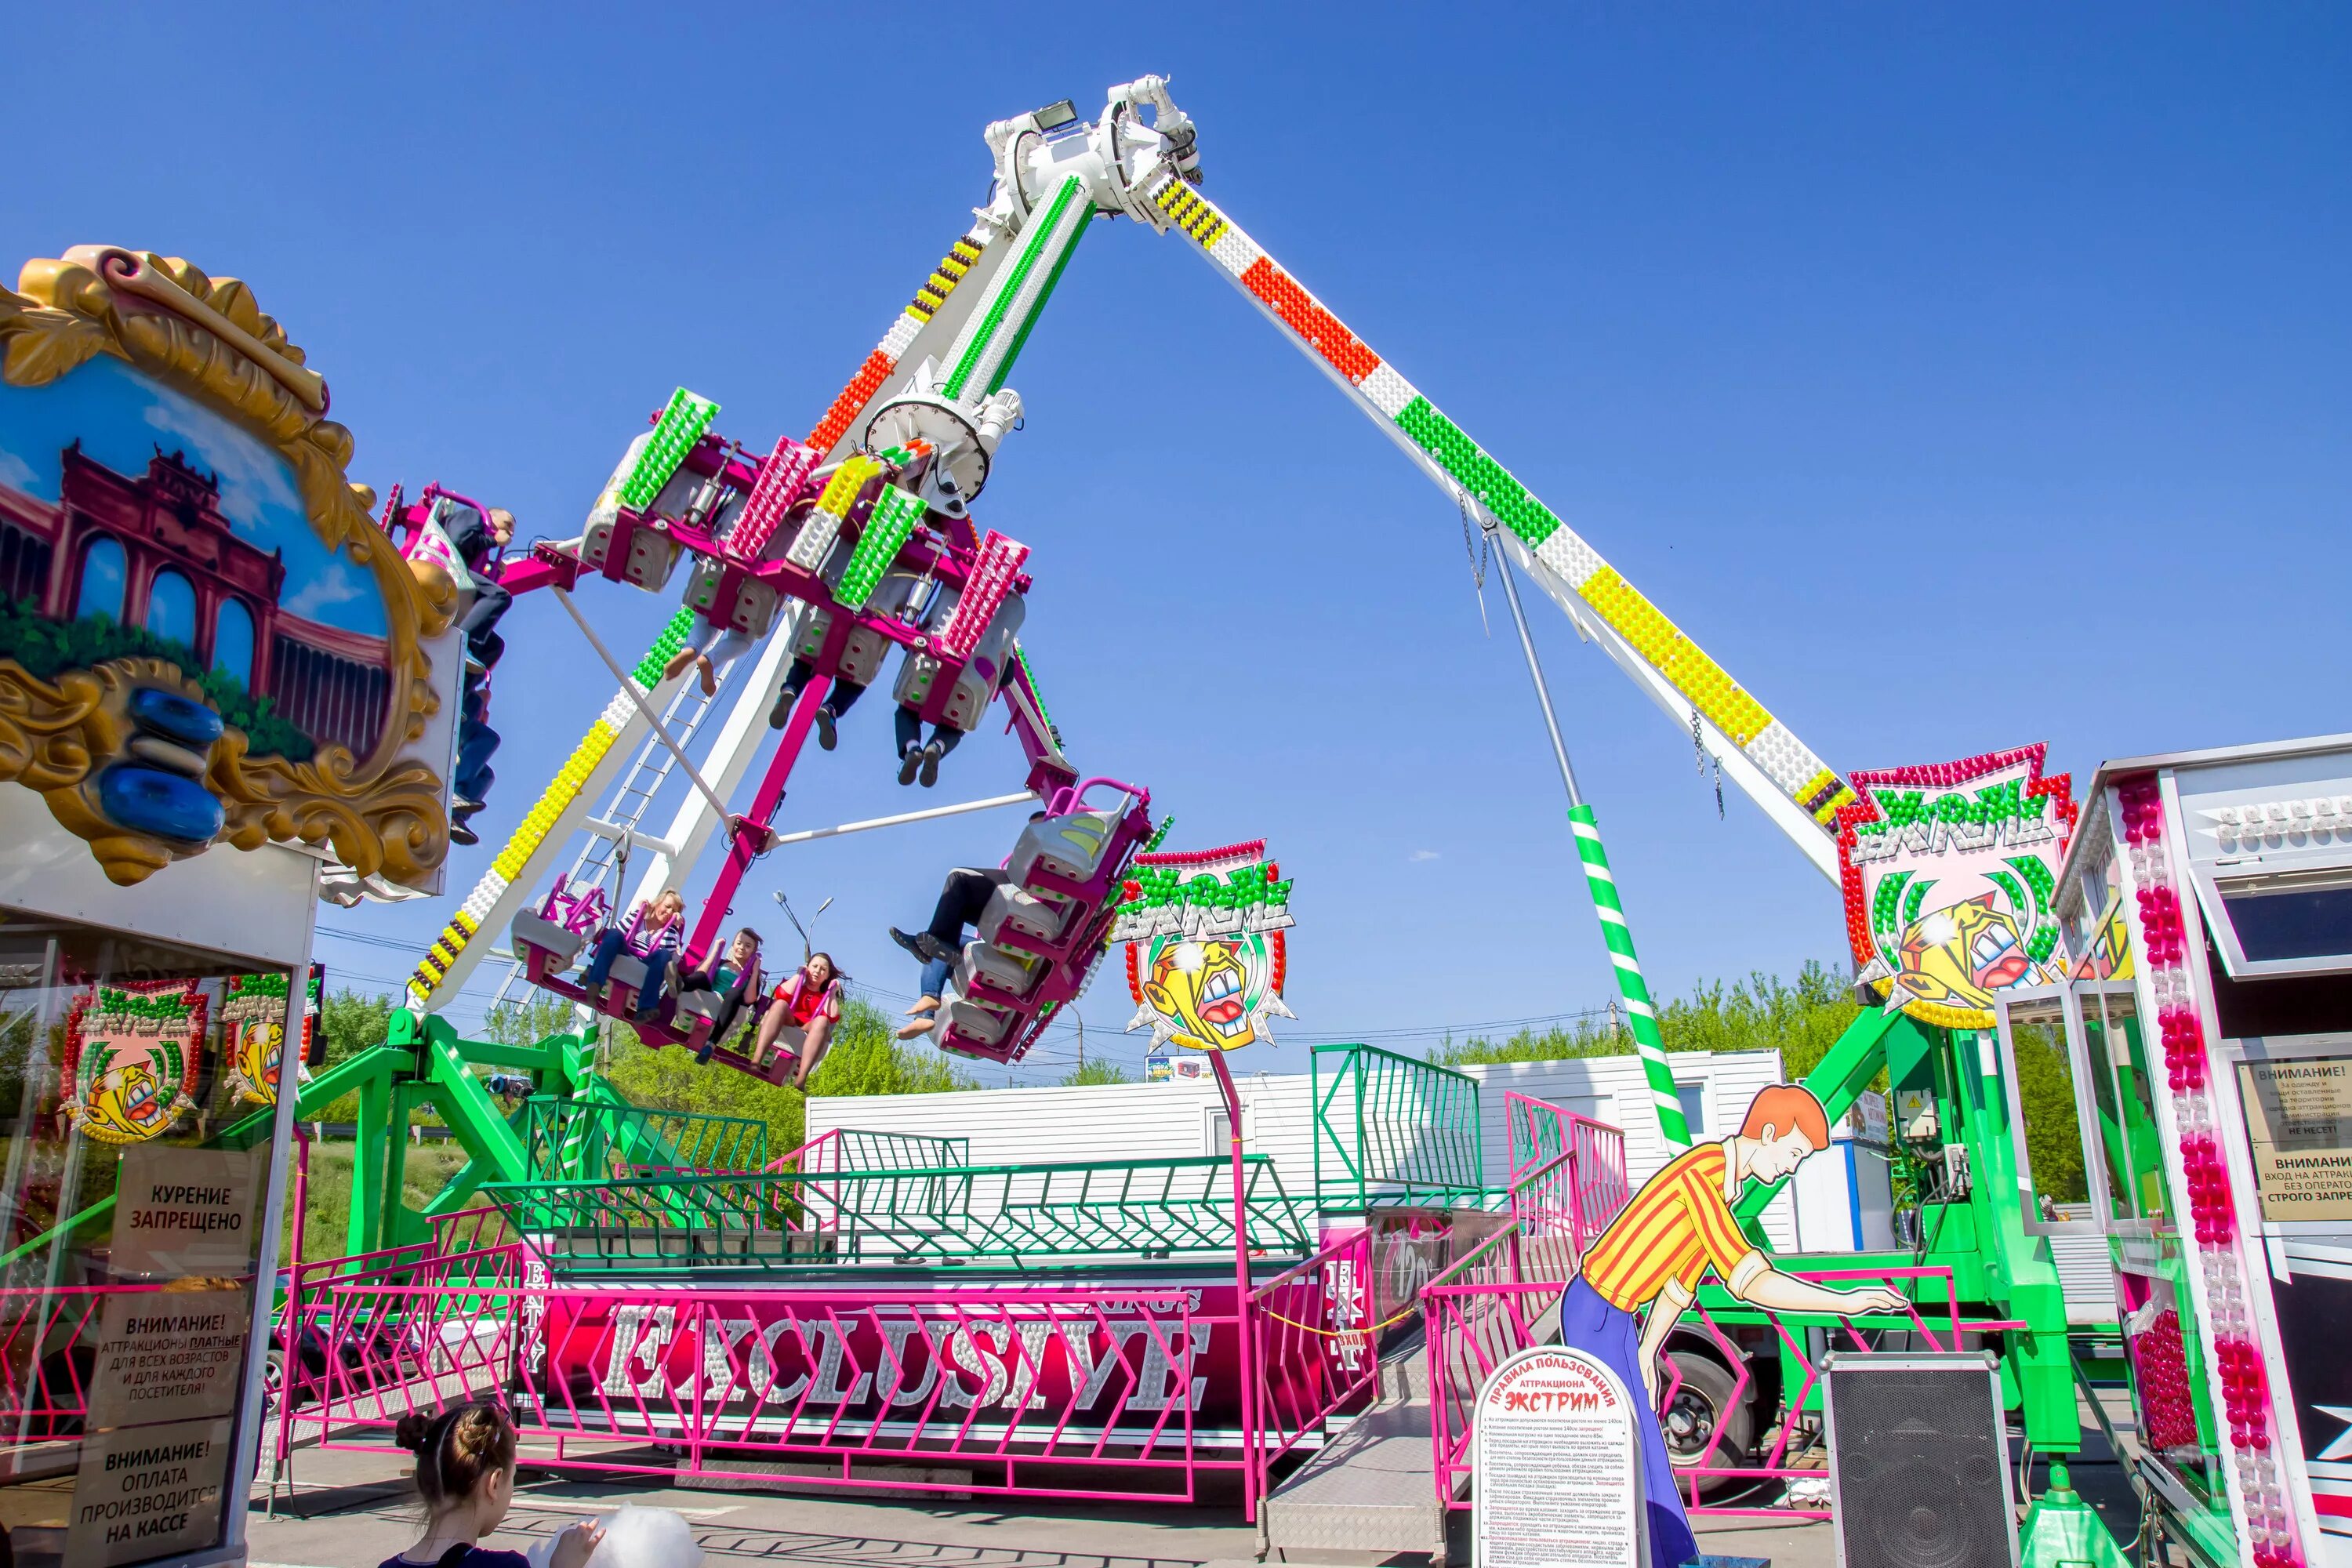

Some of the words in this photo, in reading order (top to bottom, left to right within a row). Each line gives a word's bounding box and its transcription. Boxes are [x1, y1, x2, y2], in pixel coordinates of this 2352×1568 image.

[1112, 859, 1297, 943] EXTREME
[2258, 1066, 2346, 1080] ВНИМАНИЕ!
[2275, 1156, 2352, 1169] ВНИМАНИ
[2265, 1172, 2293, 1181] ВХОД
[151, 1185, 231, 1205] КУРЕНИЕ
[2268, 1192, 2313, 1202] СТРОГО
[130, 1210, 241, 1233] ЗАПРЕЩЕНО
[126, 1314, 226, 1334] ВНИМАНИЕ!
[520, 1261, 549, 1373] ENTRY
[101, 1338, 187, 1354] АТТРАКЦИОНЫ
[189, 1334, 241, 1349] ПЛАТНЫЕ
[1339, 1331, 1366, 1347] ВХОД
[110, 1357, 136, 1371] ДЛЯ
[139, 1354, 166, 1367] ВСЕХ
[169, 1351, 229, 1365] ВОЗРАСТОВ
[592, 1305, 1210, 1412] EXCLUSIVE
[123, 1373, 132, 1385] И
[134, 1371, 158, 1385] ДЛЯ
[162, 1367, 216, 1382] КАЖДОГО
[1490, 1361, 1534, 1405] ПРАВИЛА
[1536, 1358, 1616, 1407] ПОЛЬЗОВАНИЯ
[129, 1383, 205, 1401] ПОСЕТИТЕЛЯ!
[1504, 1391, 1599, 1413] ЭКСТРИМ
[105, 1439, 210, 1471] ВНИМАНИЕ!
[122, 1468, 188, 1492] ОПЛАТА
[80, 1485, 217, 1524] ПРОИЗВОДИТСЯ
[106, 1524, 131, 1544] НА
[136, 1513, 189, 1538] КАССЕ
